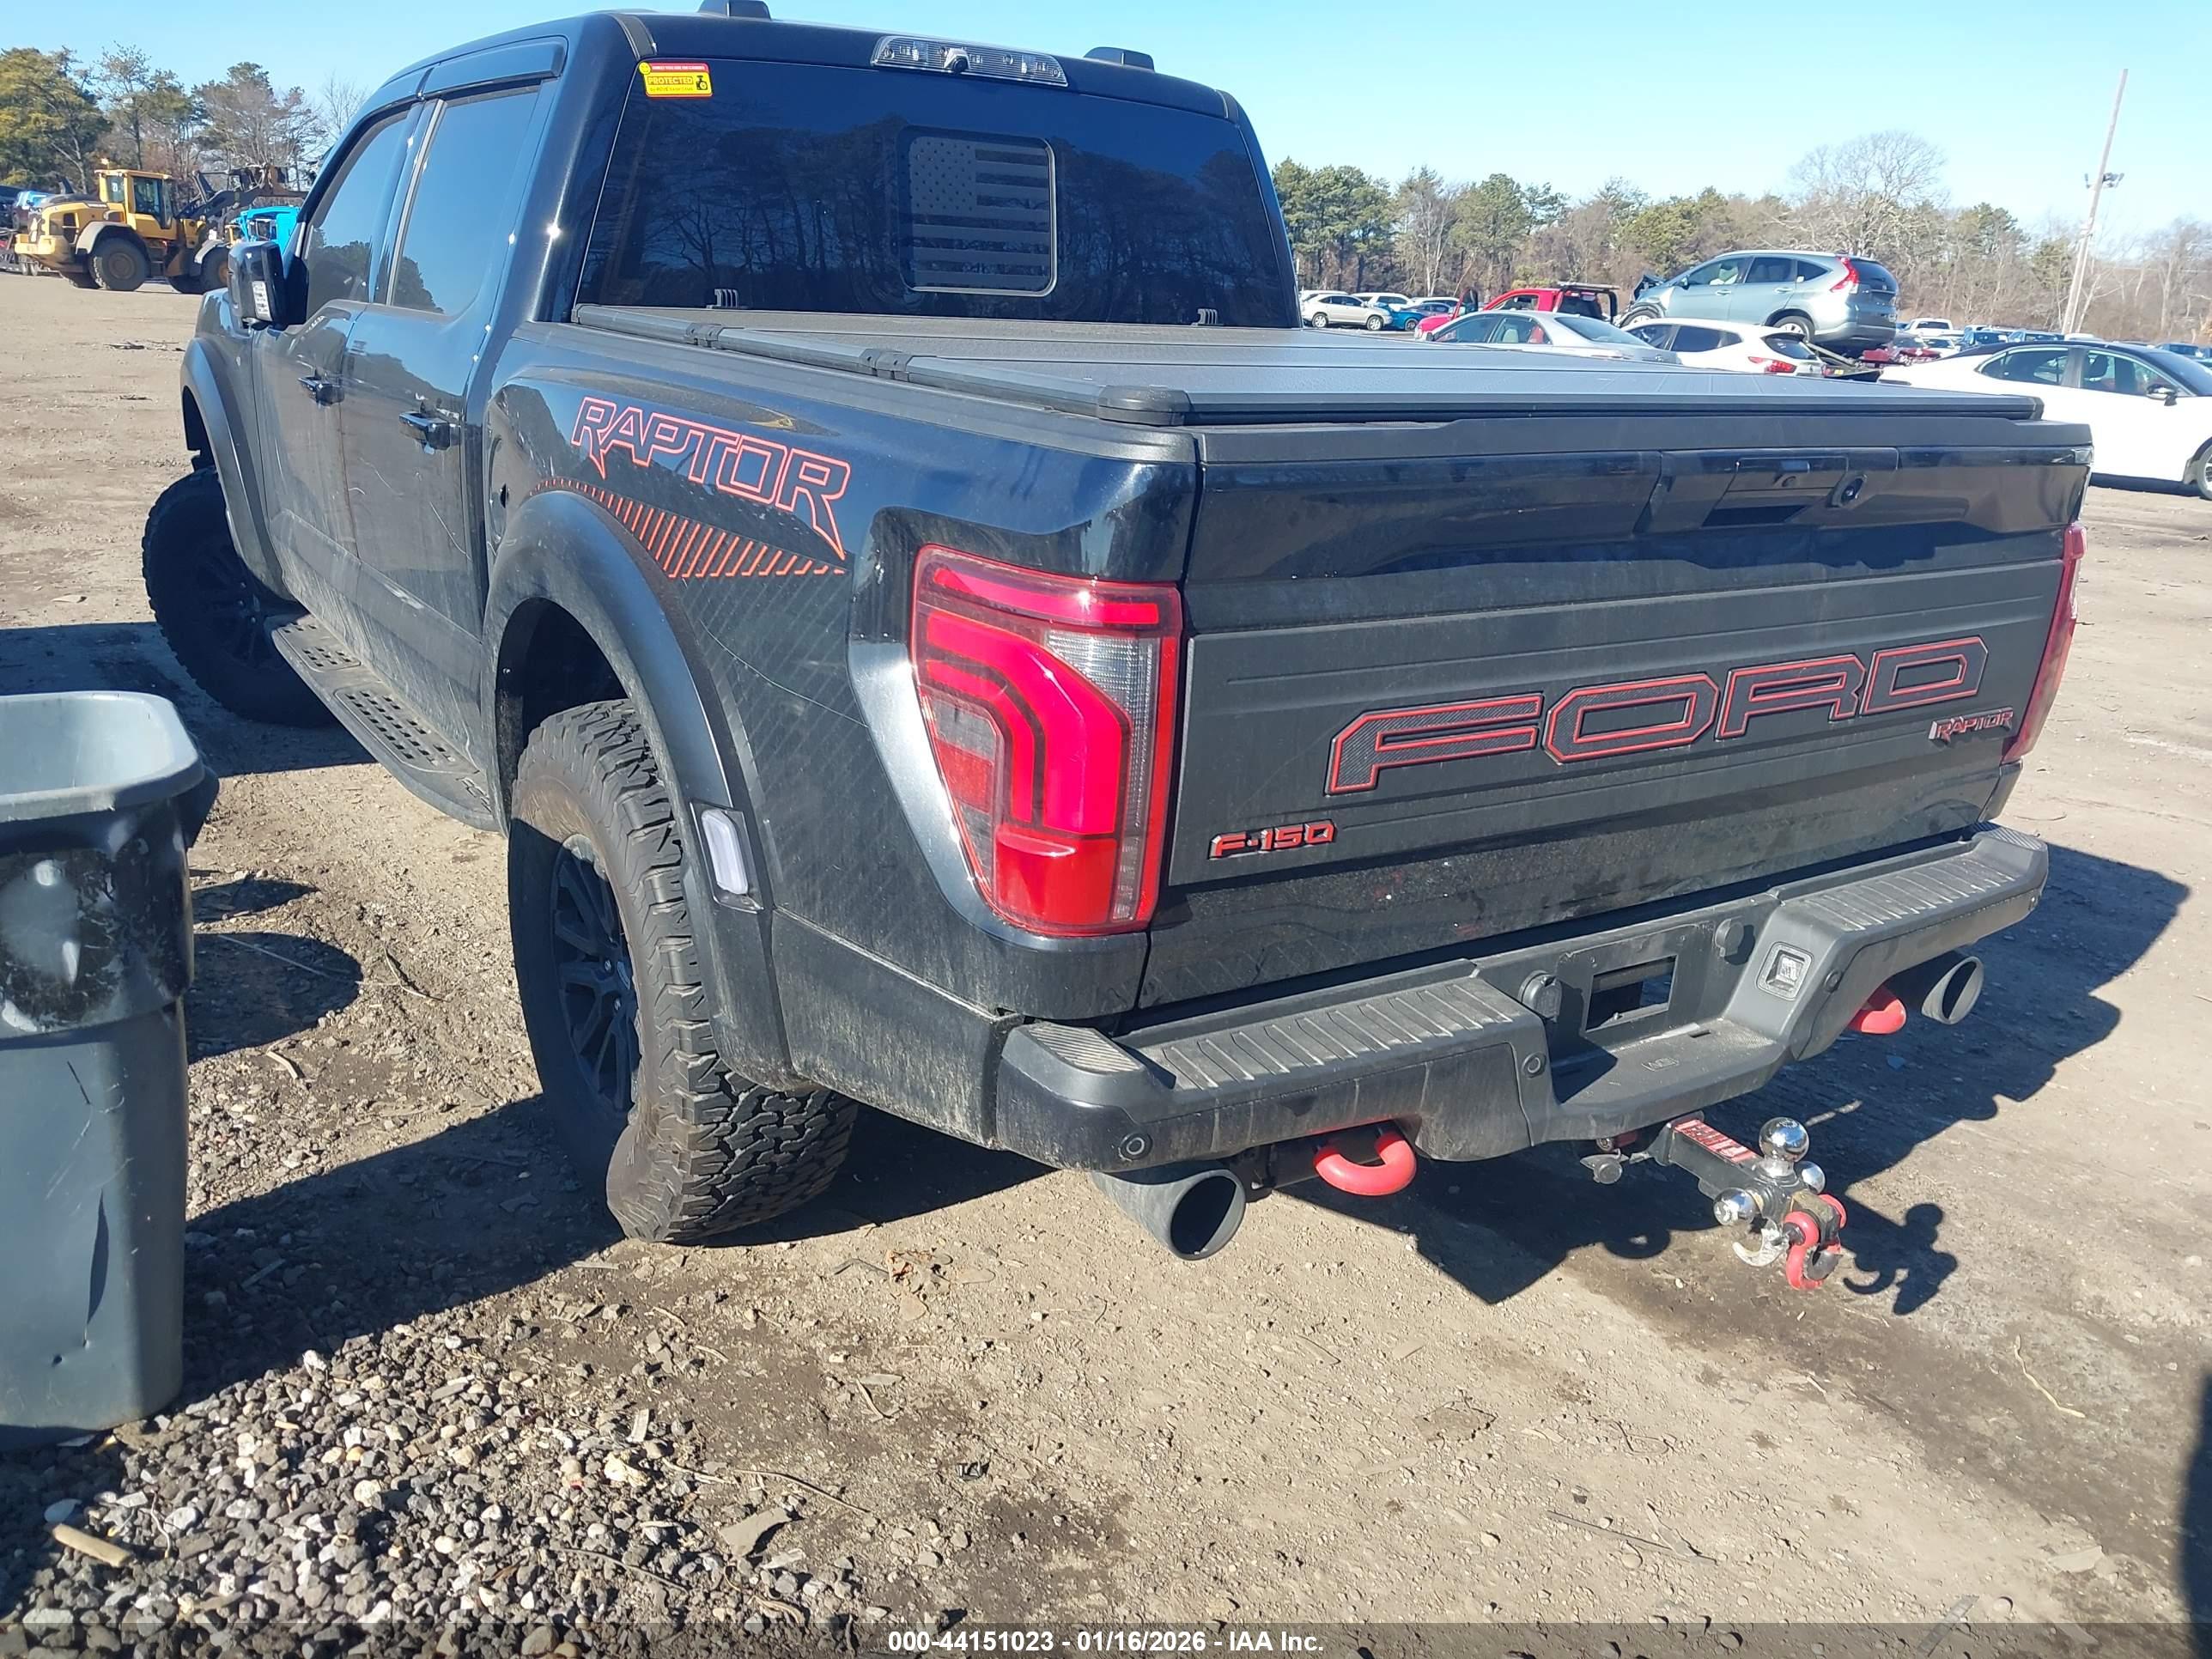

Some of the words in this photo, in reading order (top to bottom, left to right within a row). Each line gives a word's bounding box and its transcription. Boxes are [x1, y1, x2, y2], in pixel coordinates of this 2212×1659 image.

[647, 76, 694, 85] PROTECTED
[571, 396, 851, 561] RAPTOR
[1323, 635, 1989, 797] FORD
[1929, 706, 2014, 742] RAPTOR
[1208, 818, 1338, 860] F-150
